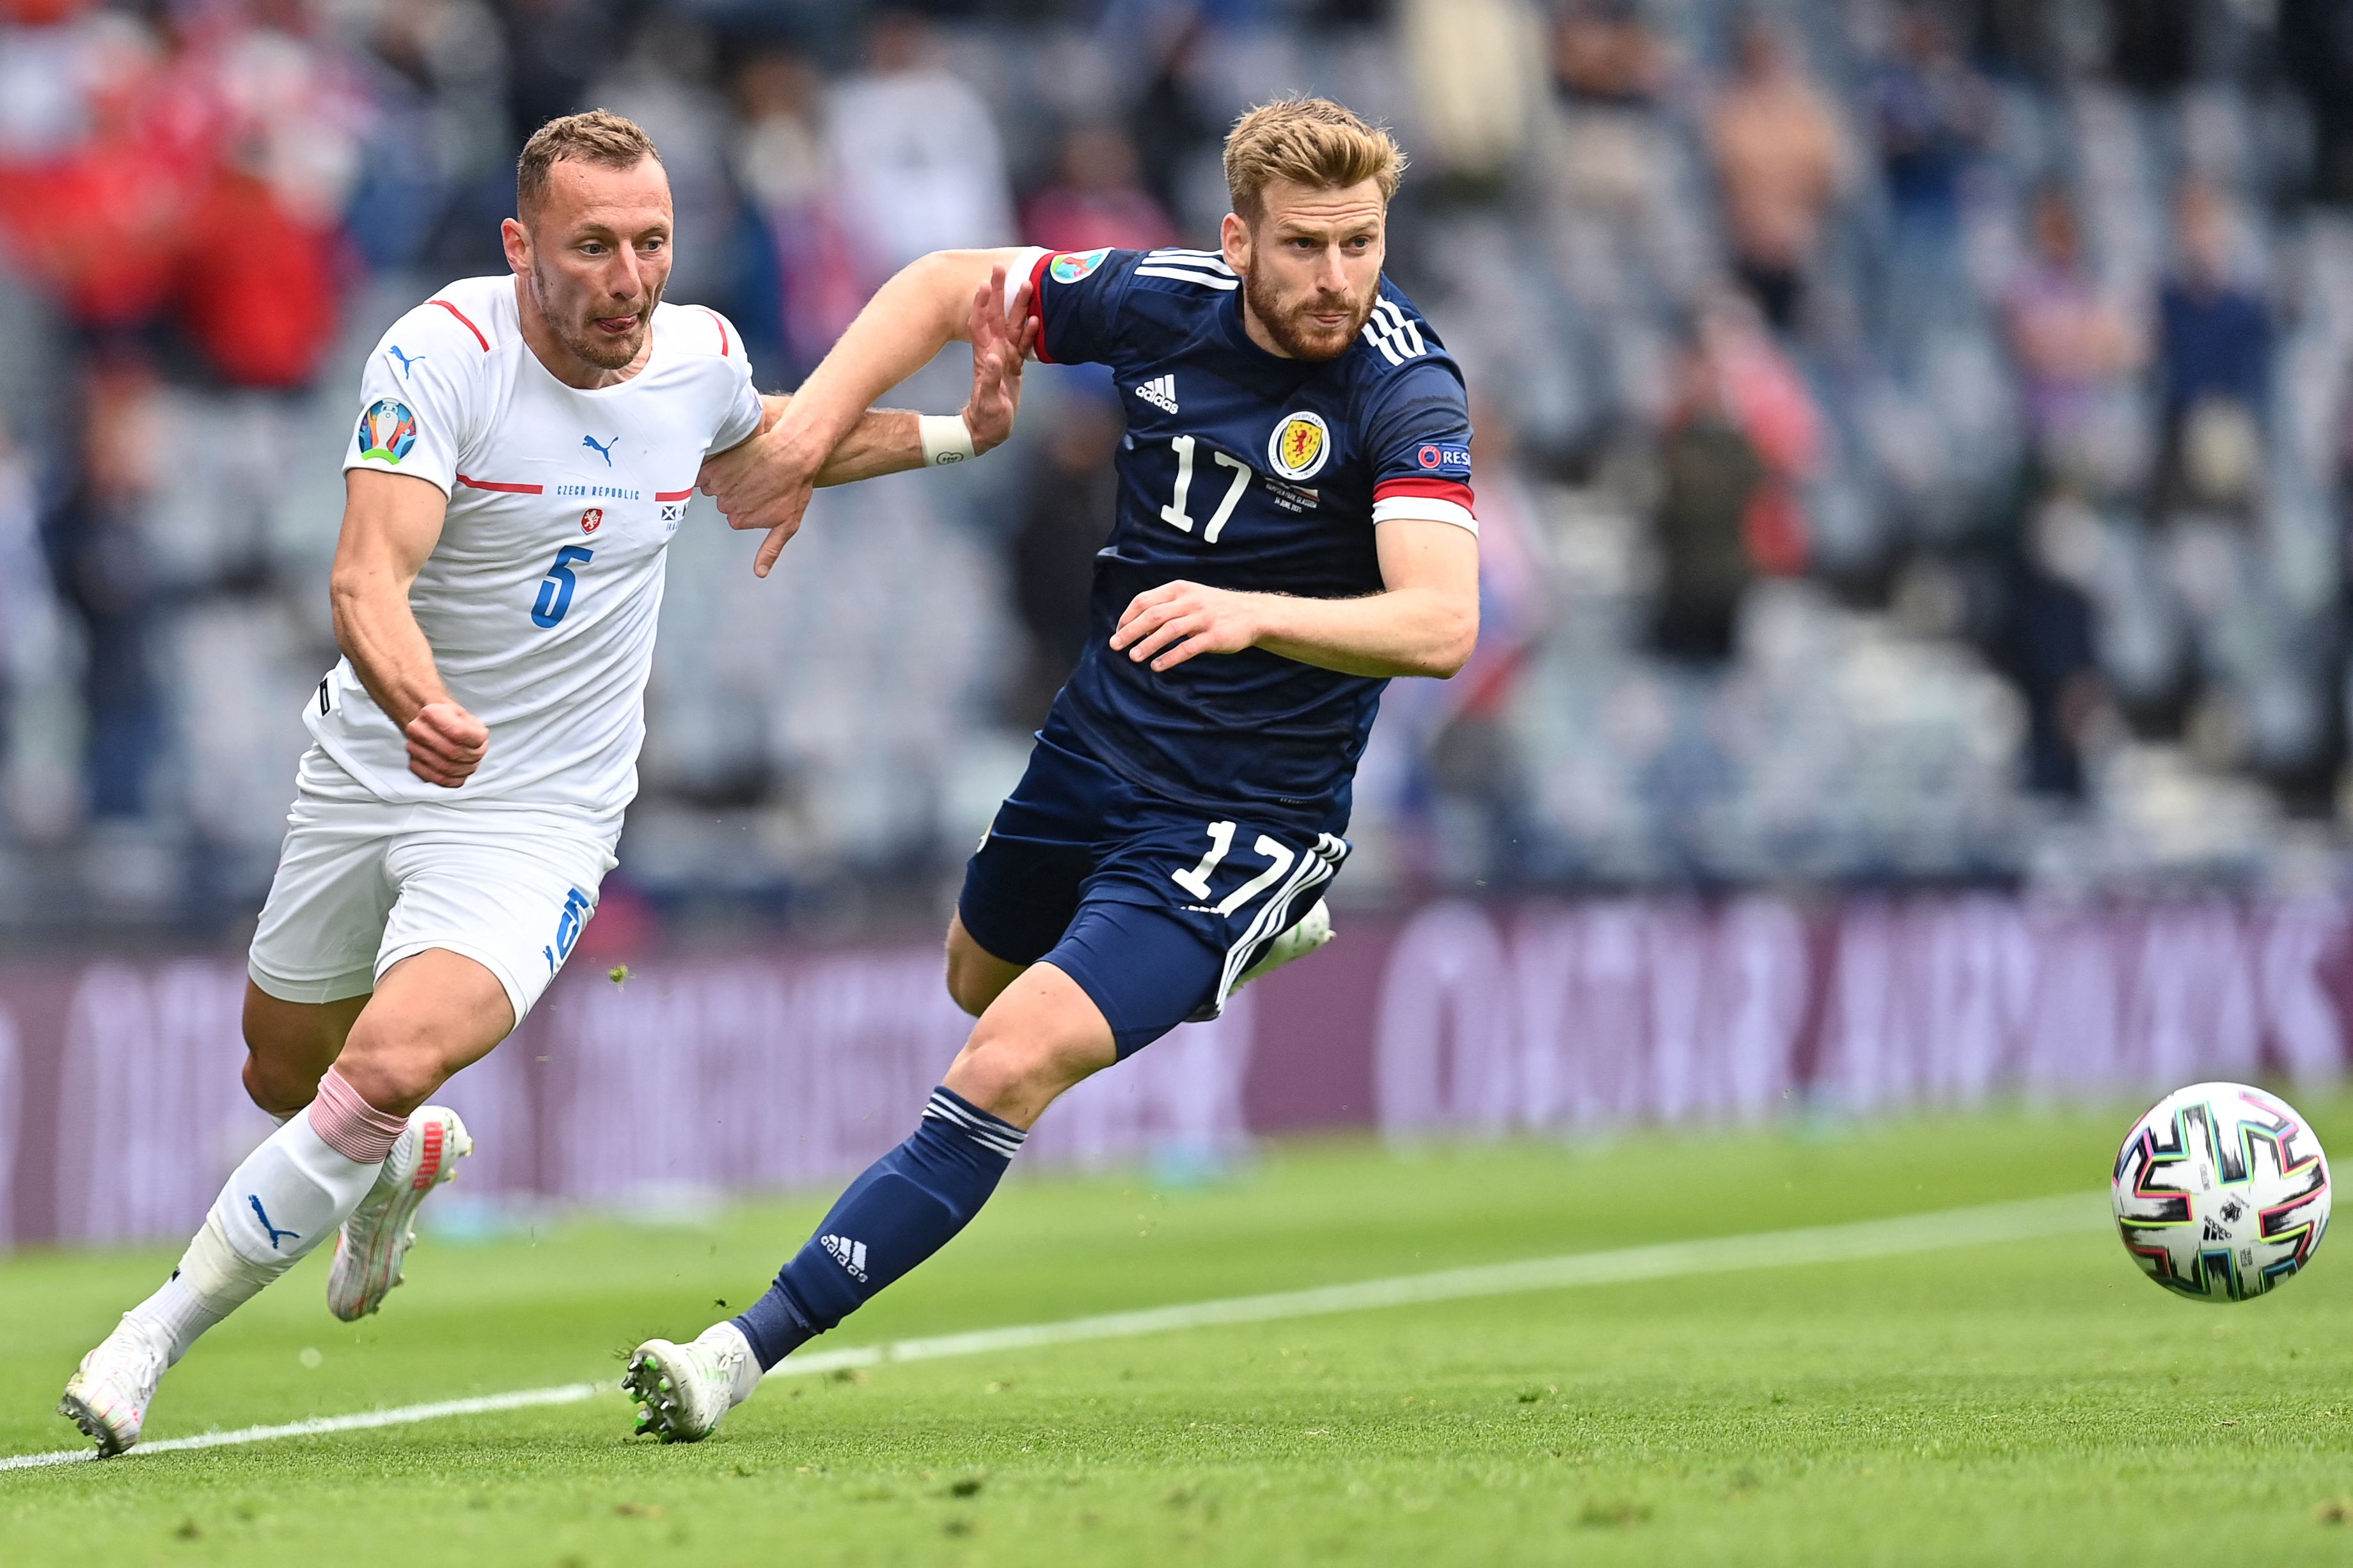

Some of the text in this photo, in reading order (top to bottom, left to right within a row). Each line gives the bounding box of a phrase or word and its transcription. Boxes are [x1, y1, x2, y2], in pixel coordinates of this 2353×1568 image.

[1135, 386, 1179, 414] adidas
[557, 485, 640, 500] CZECH REPUBLIC
[1160, 435, 1252, 544] 17
[531, 545, 594, 629] 5
[1171, 820, 1295, 918] 17
[820, 1235, 869, 1283] adidas
